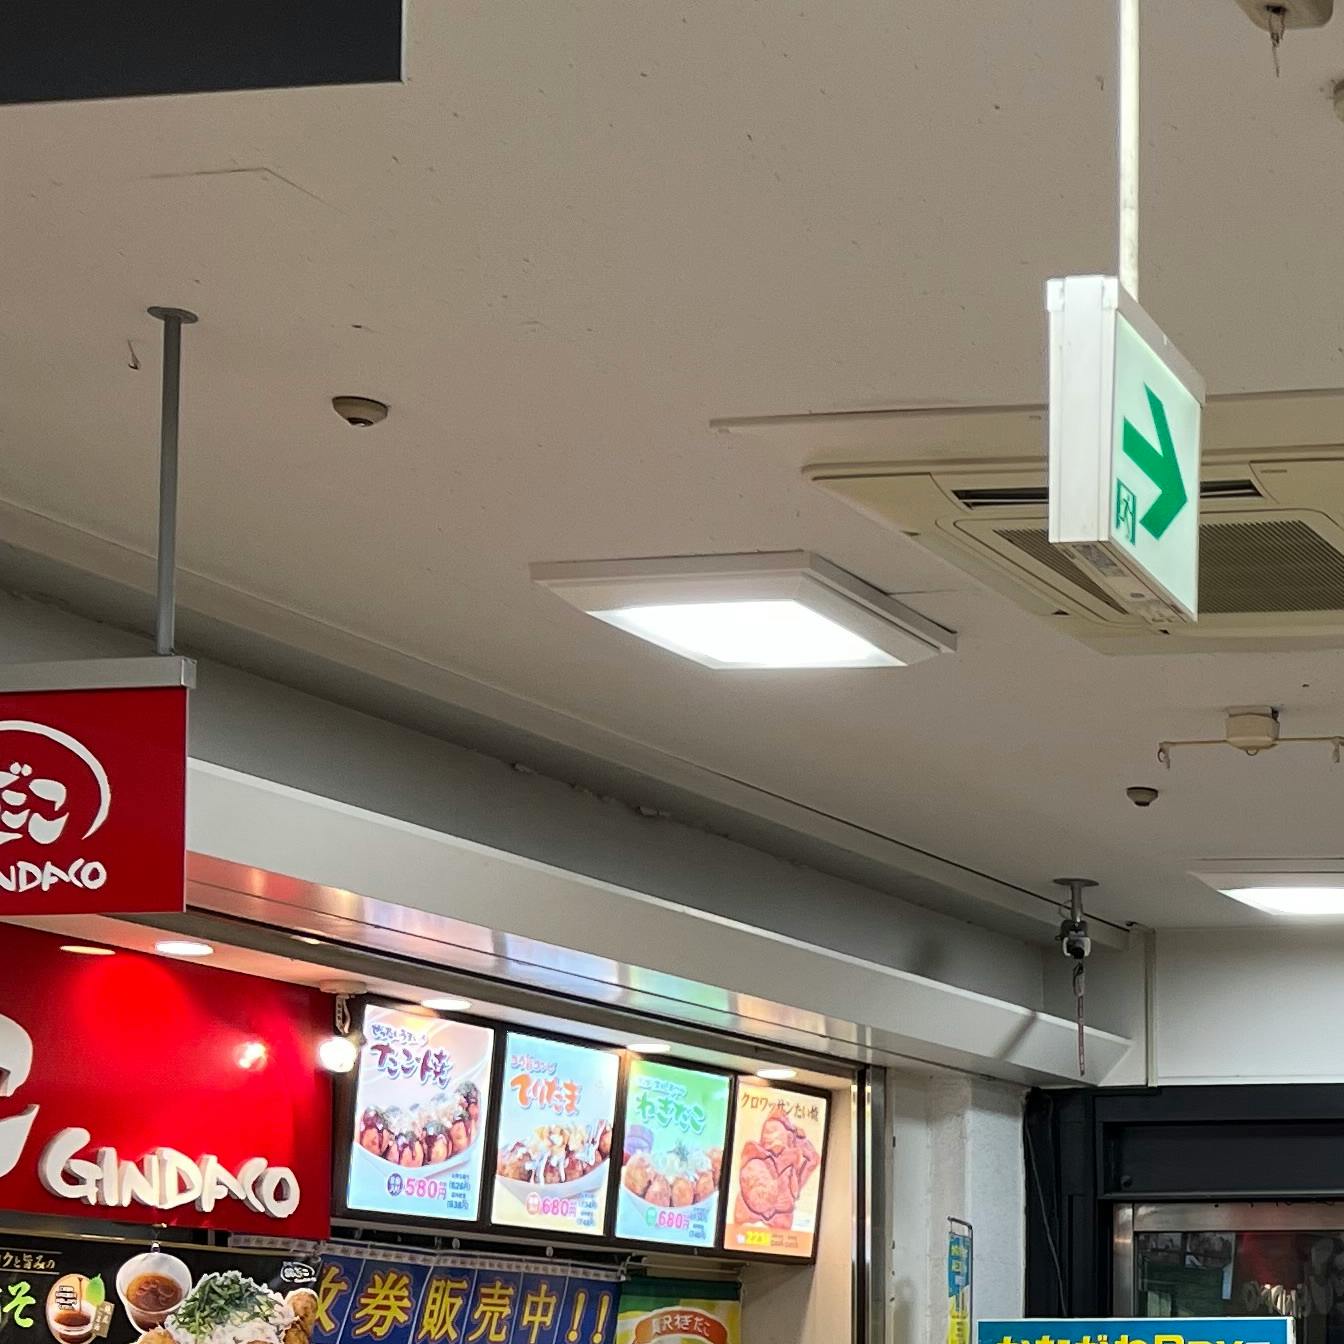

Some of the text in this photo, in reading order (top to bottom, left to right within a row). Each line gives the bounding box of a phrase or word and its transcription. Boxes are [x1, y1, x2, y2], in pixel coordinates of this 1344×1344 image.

[510, 1073, 582, 1116] てりたま
[38, 1127, 300, 1219] GINDACO
